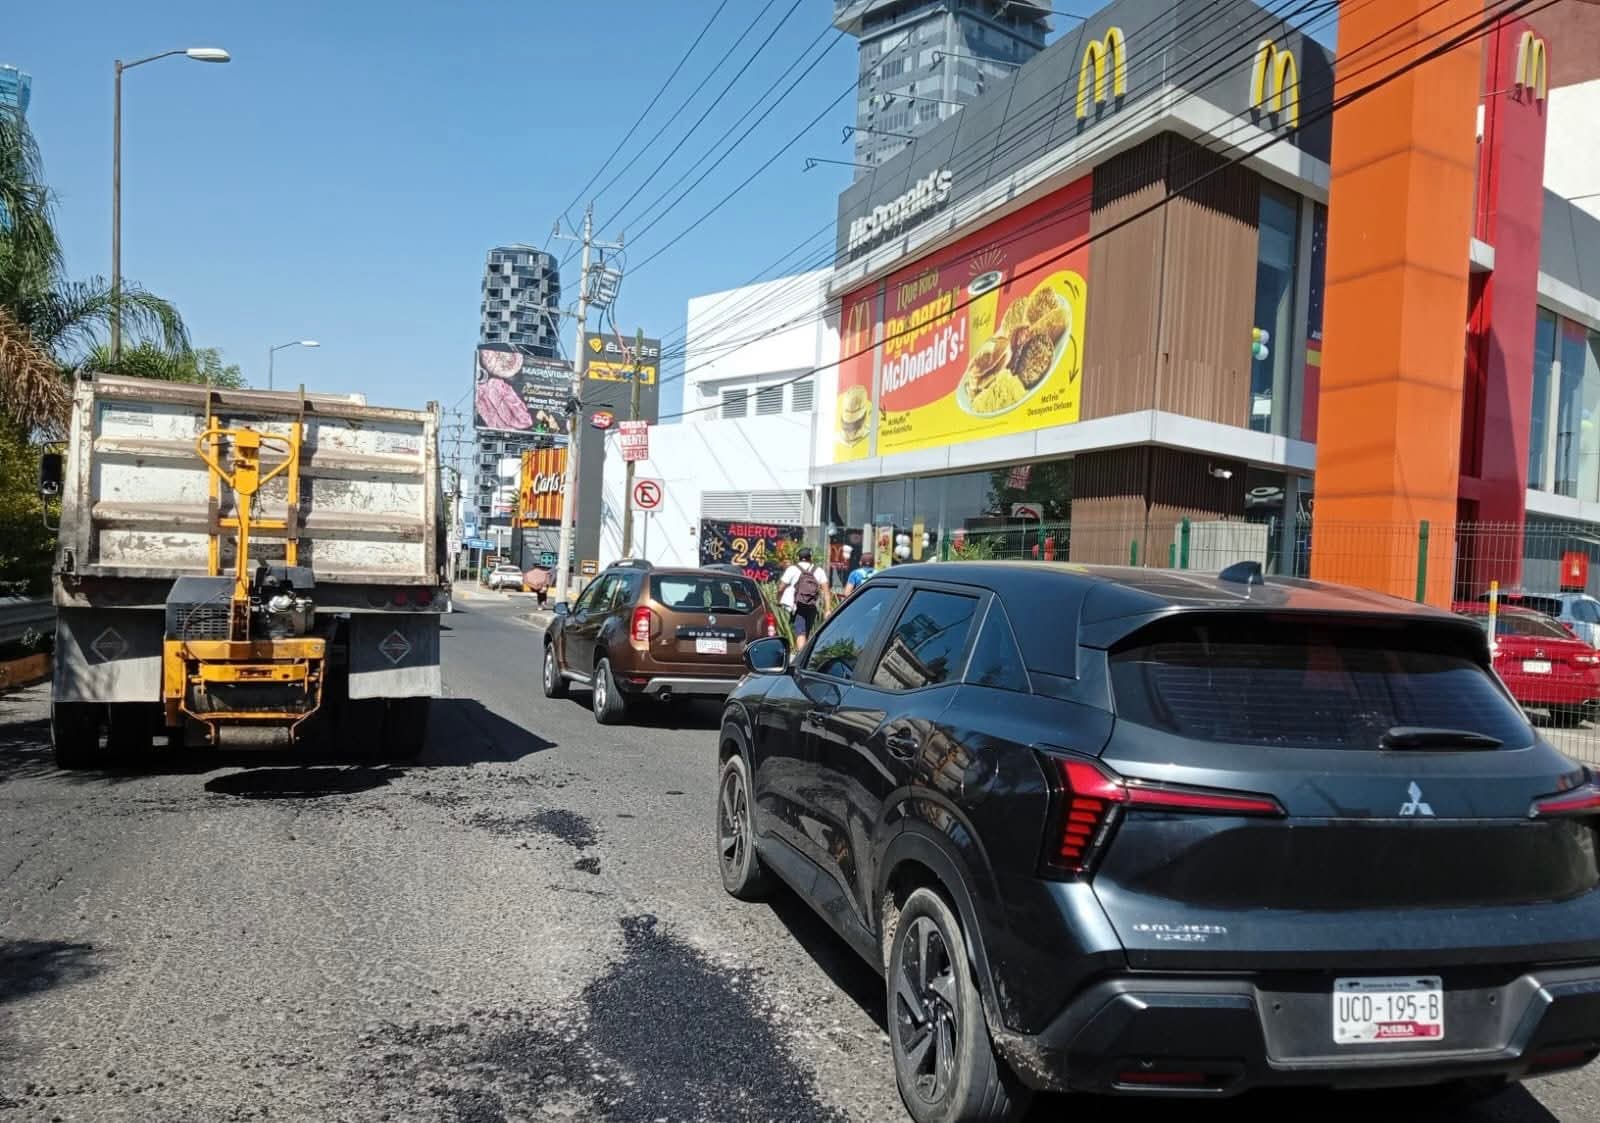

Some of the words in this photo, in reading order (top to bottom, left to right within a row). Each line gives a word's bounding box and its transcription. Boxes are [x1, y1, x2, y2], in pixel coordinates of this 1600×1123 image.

[847, 169, 953, 252] McDonald's
[881, 317, 966, 396] McDonald's!
[533, 472, 560, 495] Carl's
[728, 523, 777, 538] ABIERTO
[731, 537, 767, 567] 24
[743, 569, 769, 580] RAS
[1339, 994, 1439, 1022] UCD-195-B
